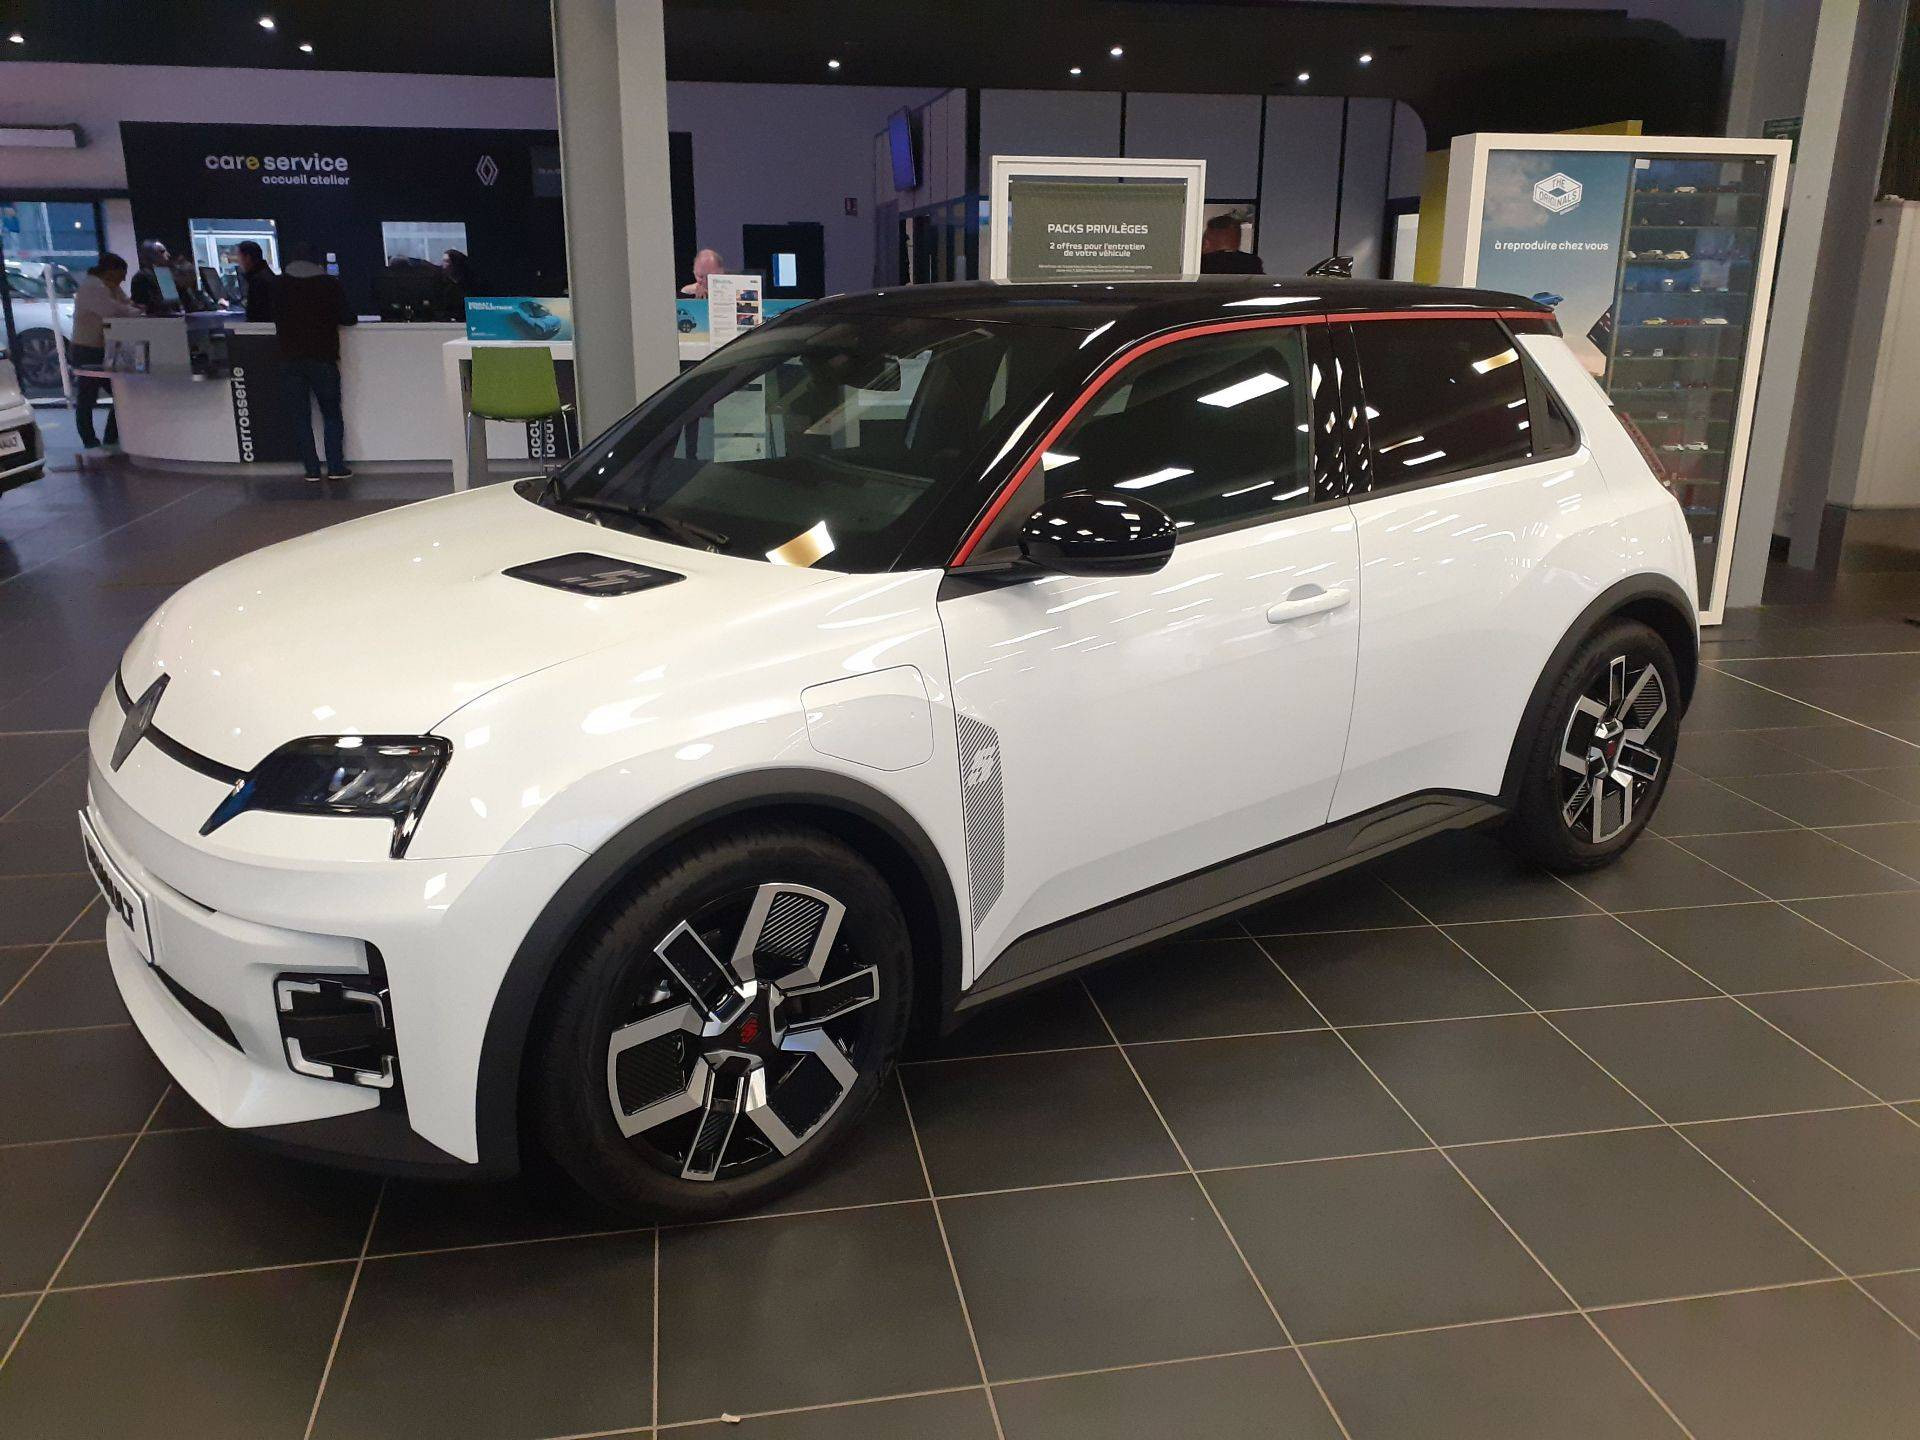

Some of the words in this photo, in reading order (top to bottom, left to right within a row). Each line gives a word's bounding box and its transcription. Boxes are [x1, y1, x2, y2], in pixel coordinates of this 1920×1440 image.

[204, 154, 260, 170] care
[263, 153, 349, 171] service
[262, 174, 308, 185] accueil
[310, 174, 350, 185] atelier
[1539, 190, 1578, 207] ORIGINALS
[1047, 223, 1084, 234] PACKS
[1086, 222, 1149, 234] PRIVILÈGES
[1049, 242, 1055, 250] 2
[1056, 242, 1083, 250] offres
[1084, 243, 1102, 251] pour
[1104, 242, 1146, 251] l'entretien
[1494, 240, 1502, 250] à
[1503, 240, 1558, 252] reproduire
[1558, 240, 1583, 250] chez
[1584, 242, 1609, 251] vous
[1063, 249, 1074, 257] de
[1099, 249, 1131, 257] véhicule
[231, 366, 255, 462] carrosserie
